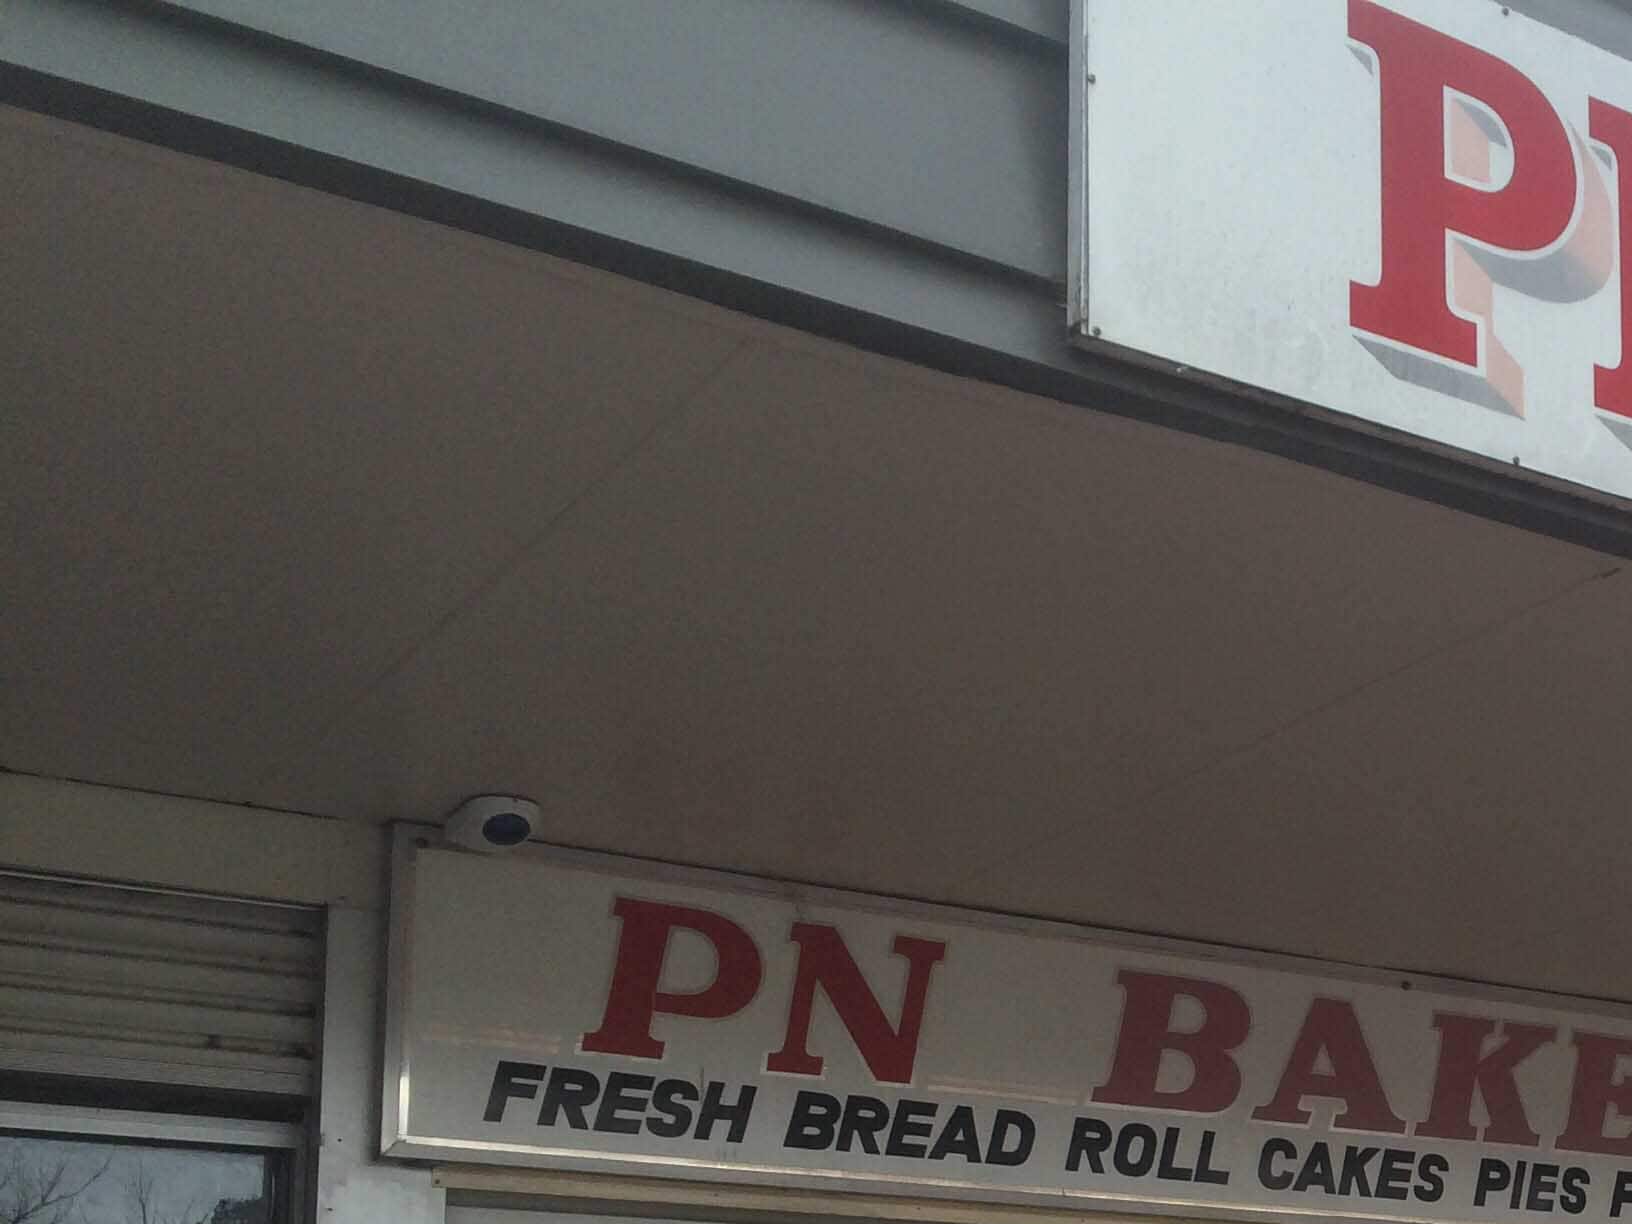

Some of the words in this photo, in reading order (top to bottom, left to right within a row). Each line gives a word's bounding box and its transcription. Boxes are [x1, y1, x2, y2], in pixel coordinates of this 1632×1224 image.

[581, 896, 946, 1085] PN
[482, 1059, 758, 1144] FRESH
[782, 1089, 1036, 1168] BREAD
[1064, 1116, 1231, 1186] ROLL
[1256, 1136, 1449, 1202] CAKES
[1473, 1157, 1591, 1215] PIES
